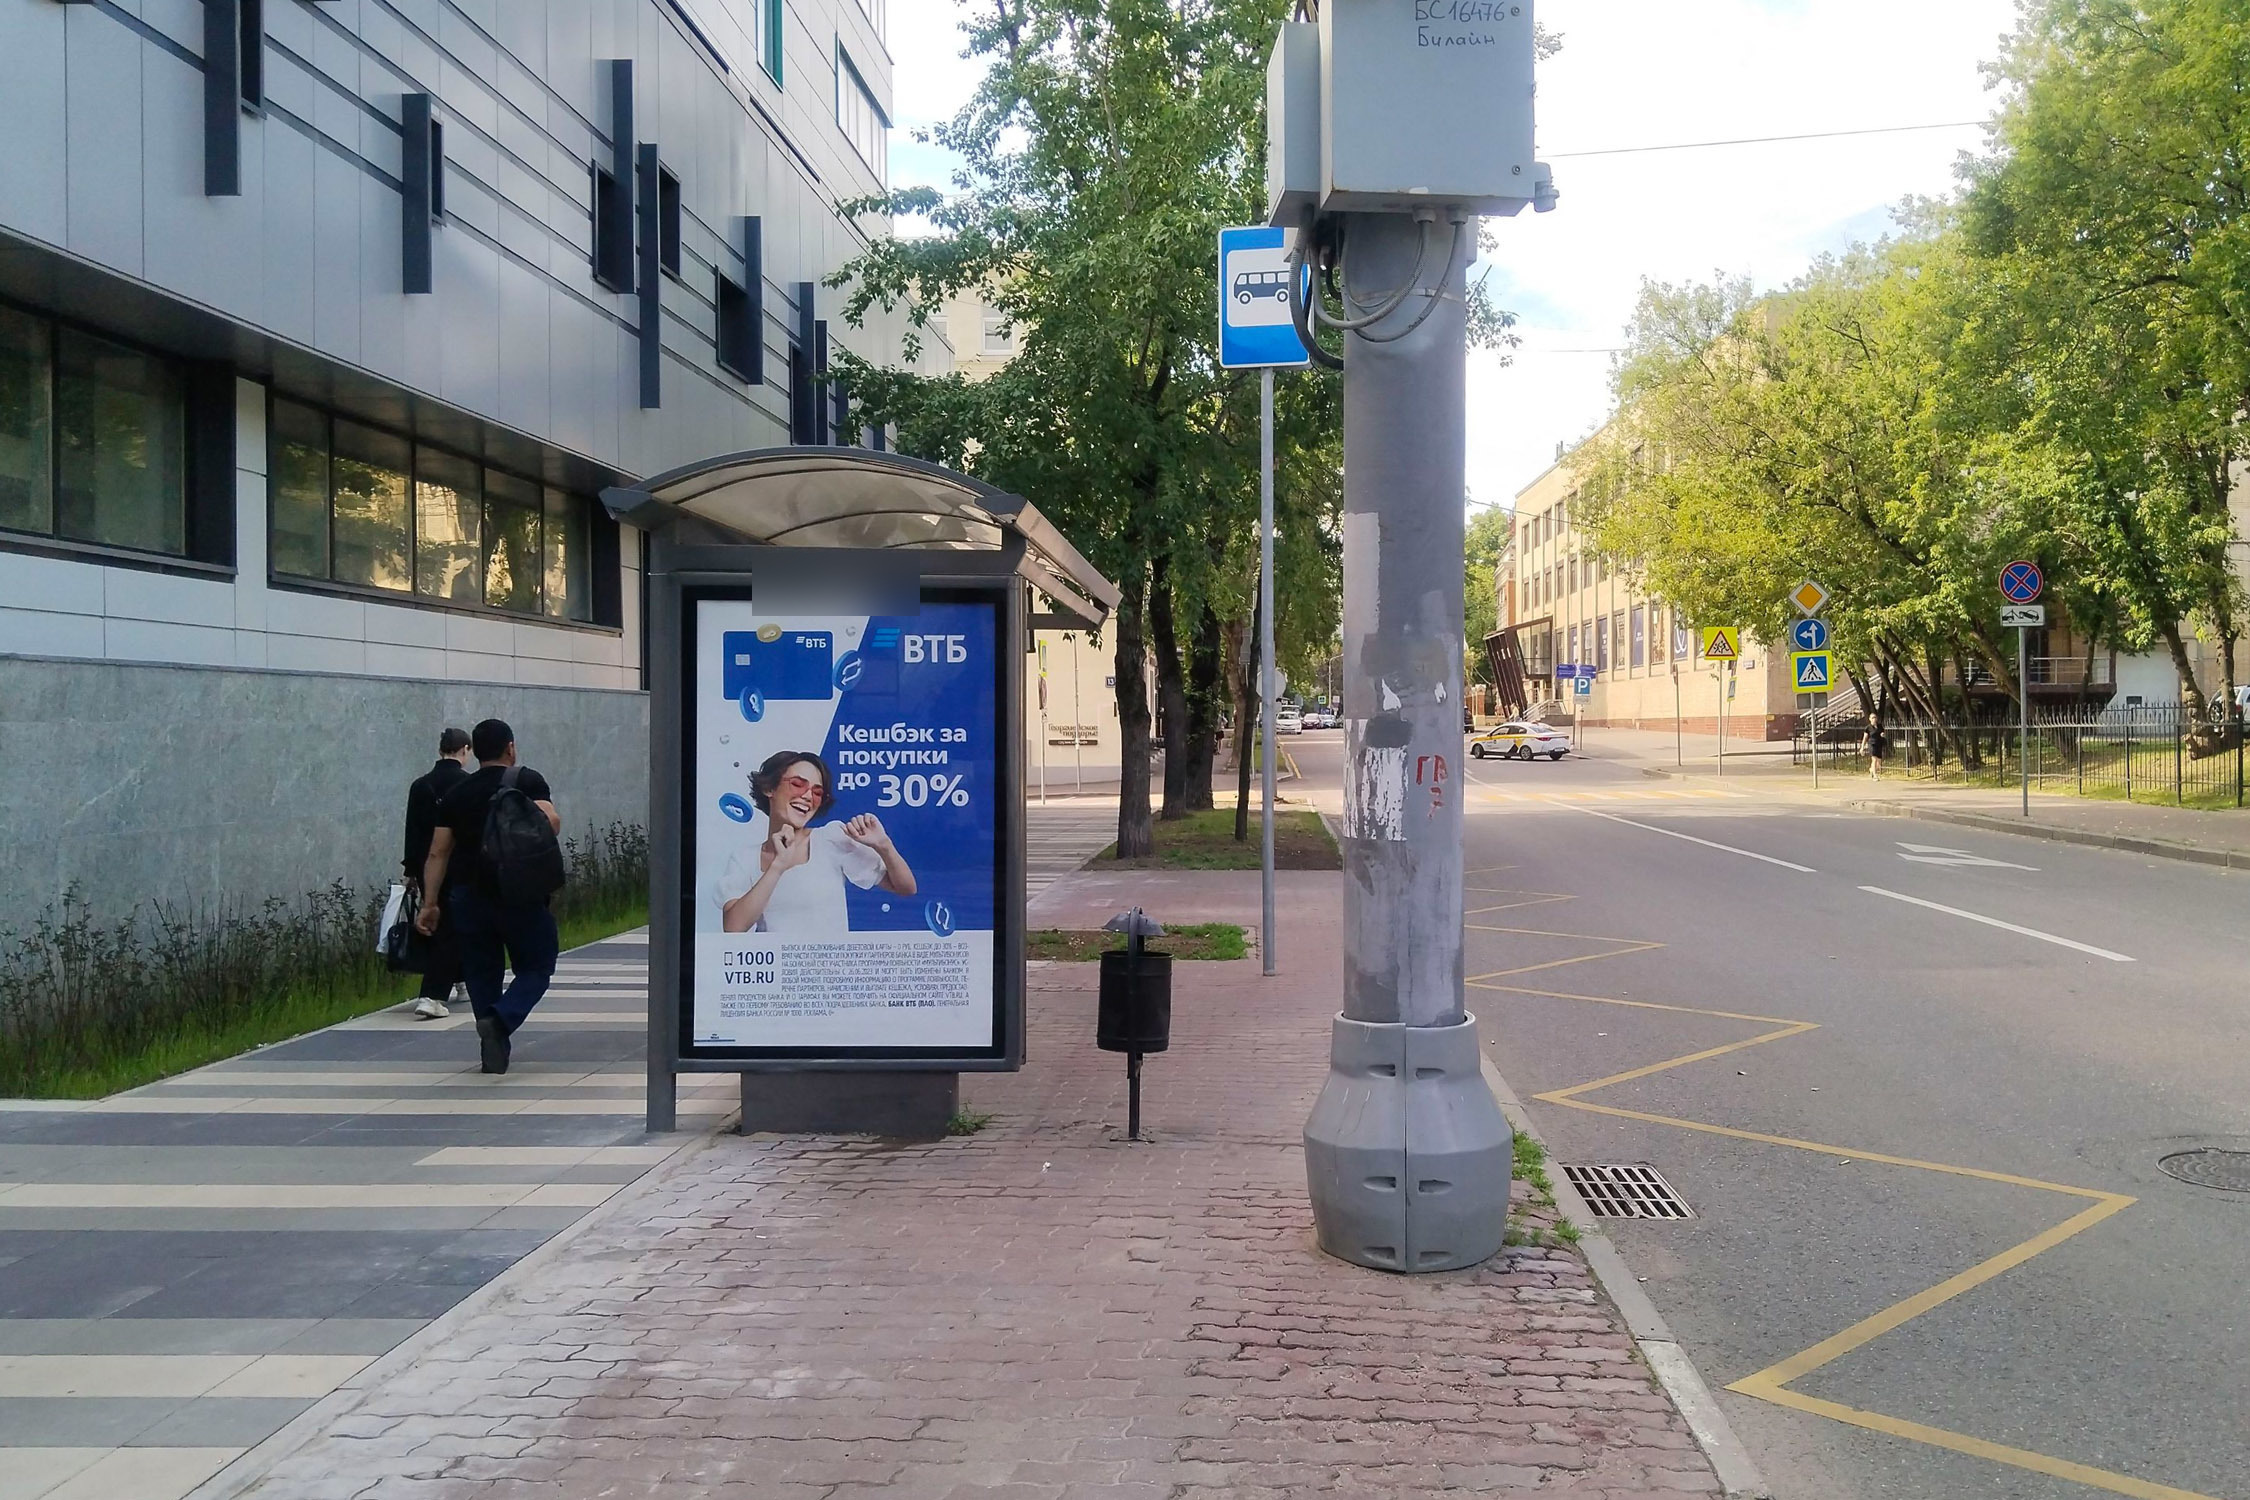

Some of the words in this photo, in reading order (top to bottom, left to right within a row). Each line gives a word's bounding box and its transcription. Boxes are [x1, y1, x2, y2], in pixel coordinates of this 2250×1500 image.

[1418, 25, 1496, 47] Билайн
[805, 638, 827, 649] ВТБ
[904, 634, 968, 663] ВТБ
[838, 722, 935, 743] Кешбэк
[940, 727, 967, 743] за
[838, 750, 948, 770] покупки
[837, 772, 871, 791] до
[877, 774, 969, 807] 30%
[736, 951, 774, 965] 1000
[725, 971, 774, 984] VTB.RU
